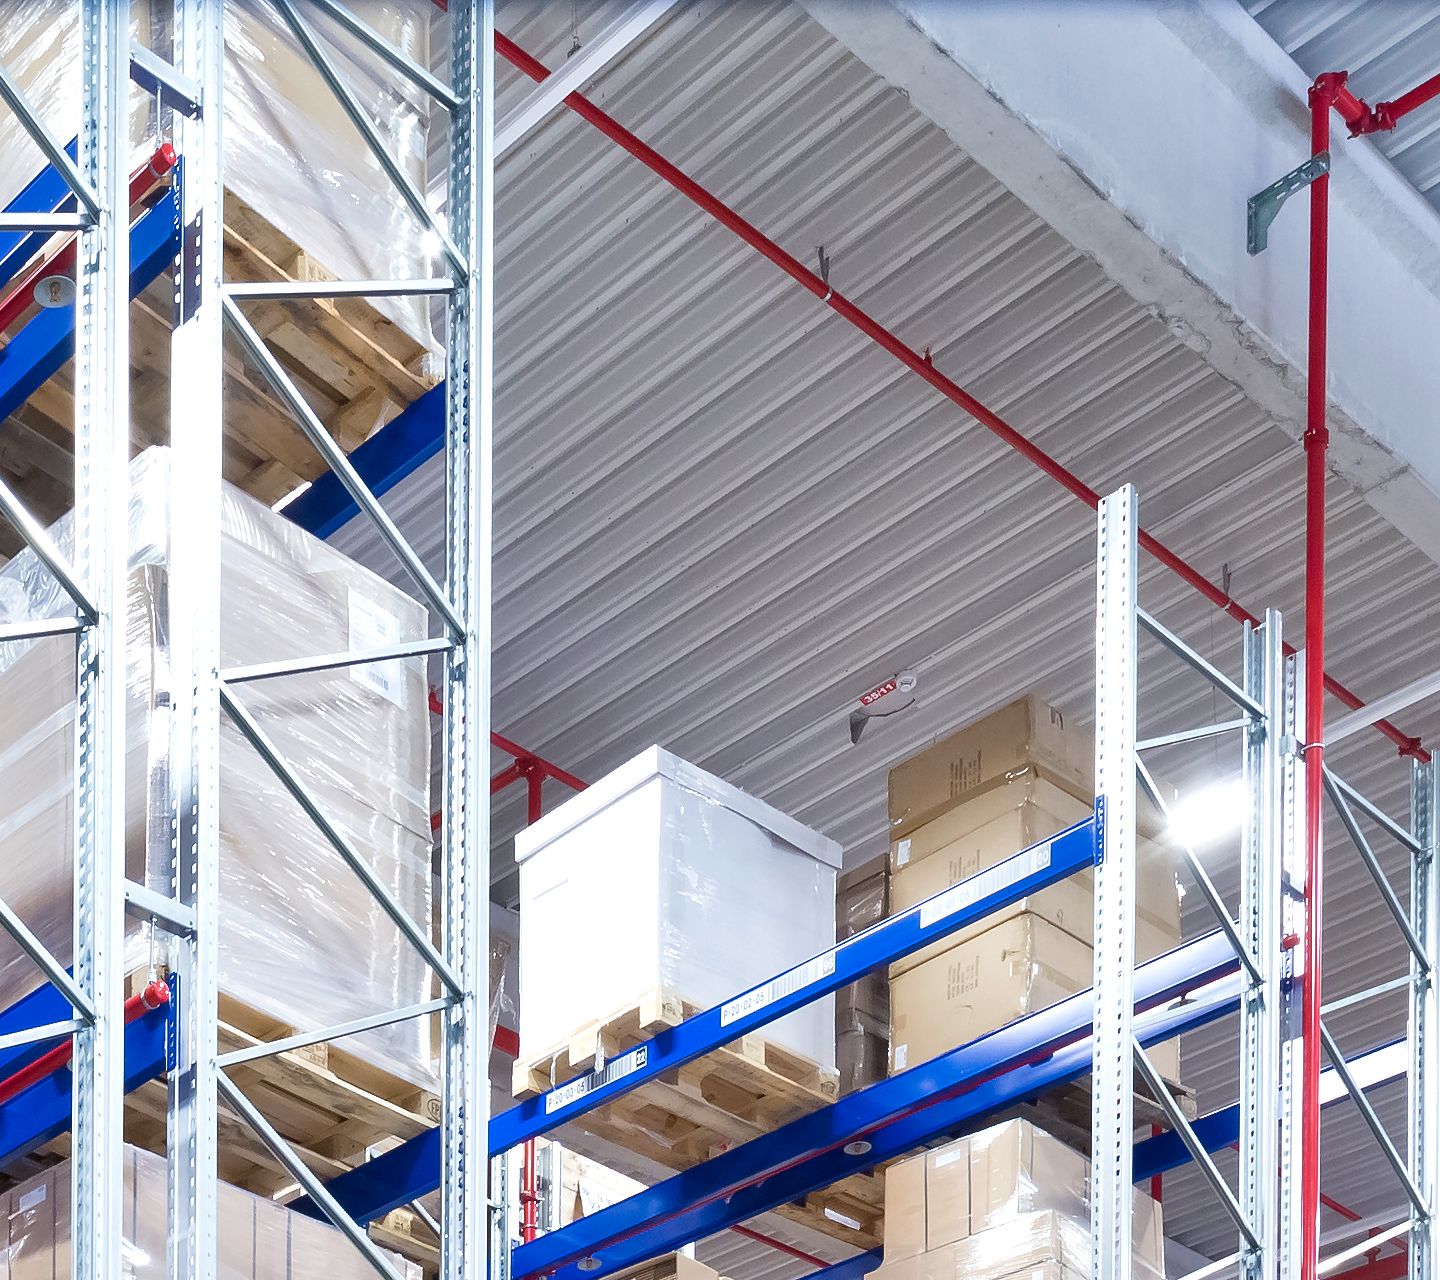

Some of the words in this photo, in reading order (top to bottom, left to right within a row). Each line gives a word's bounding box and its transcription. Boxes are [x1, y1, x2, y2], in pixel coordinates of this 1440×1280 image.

[723, 990, 766, 1022] P-20-02-05
[548, 1083, 586, 1108] P-20-03-05
[636, 1050, 646, 1065] 22
